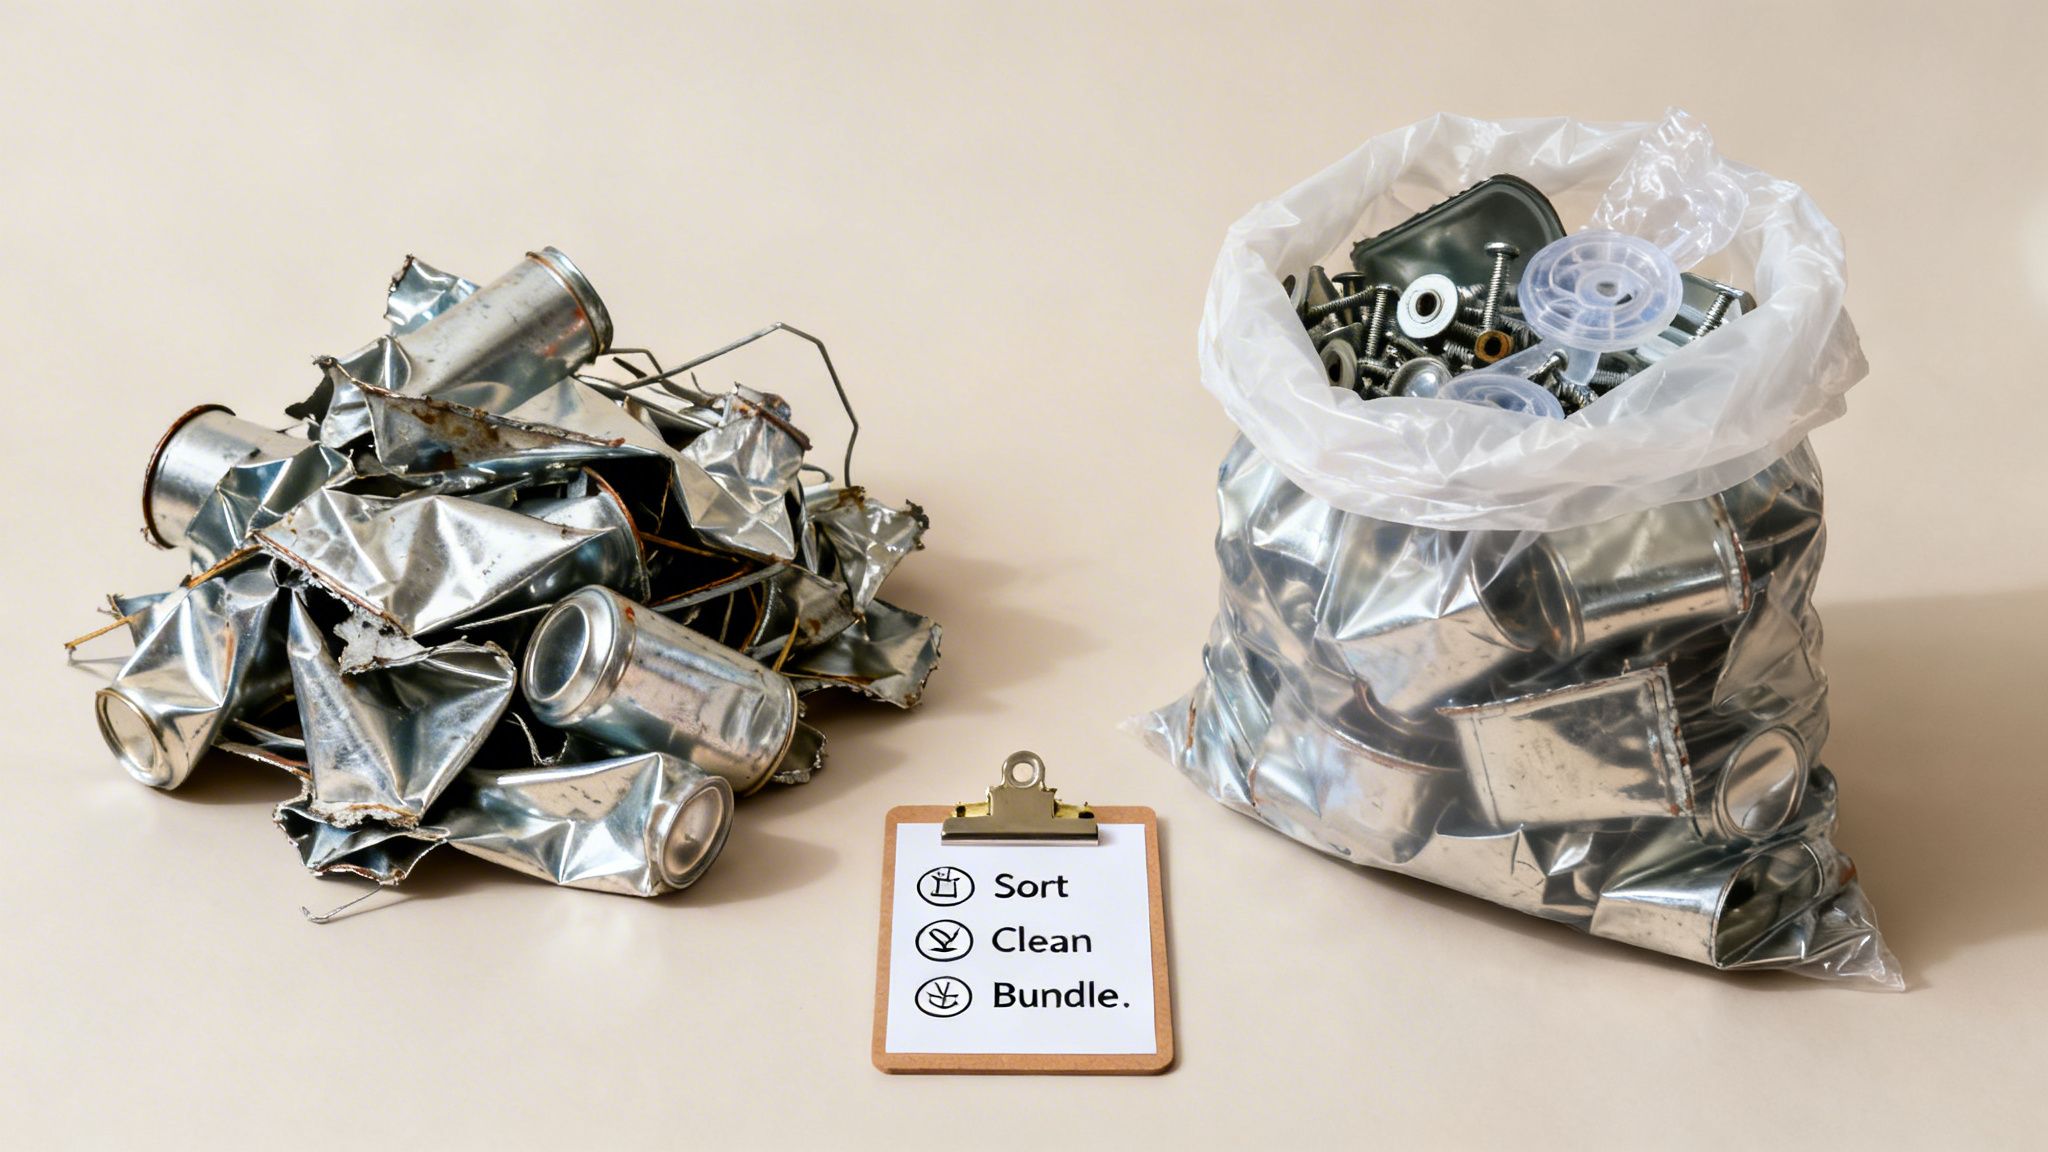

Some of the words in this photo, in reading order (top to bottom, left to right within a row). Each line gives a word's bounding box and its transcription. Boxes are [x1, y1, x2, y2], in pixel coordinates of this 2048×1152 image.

[994, 873, 1069, 899] Sort
[991, 925, 1092, 953] Clean
[993, 980, 1130, 1008] Bundle.
